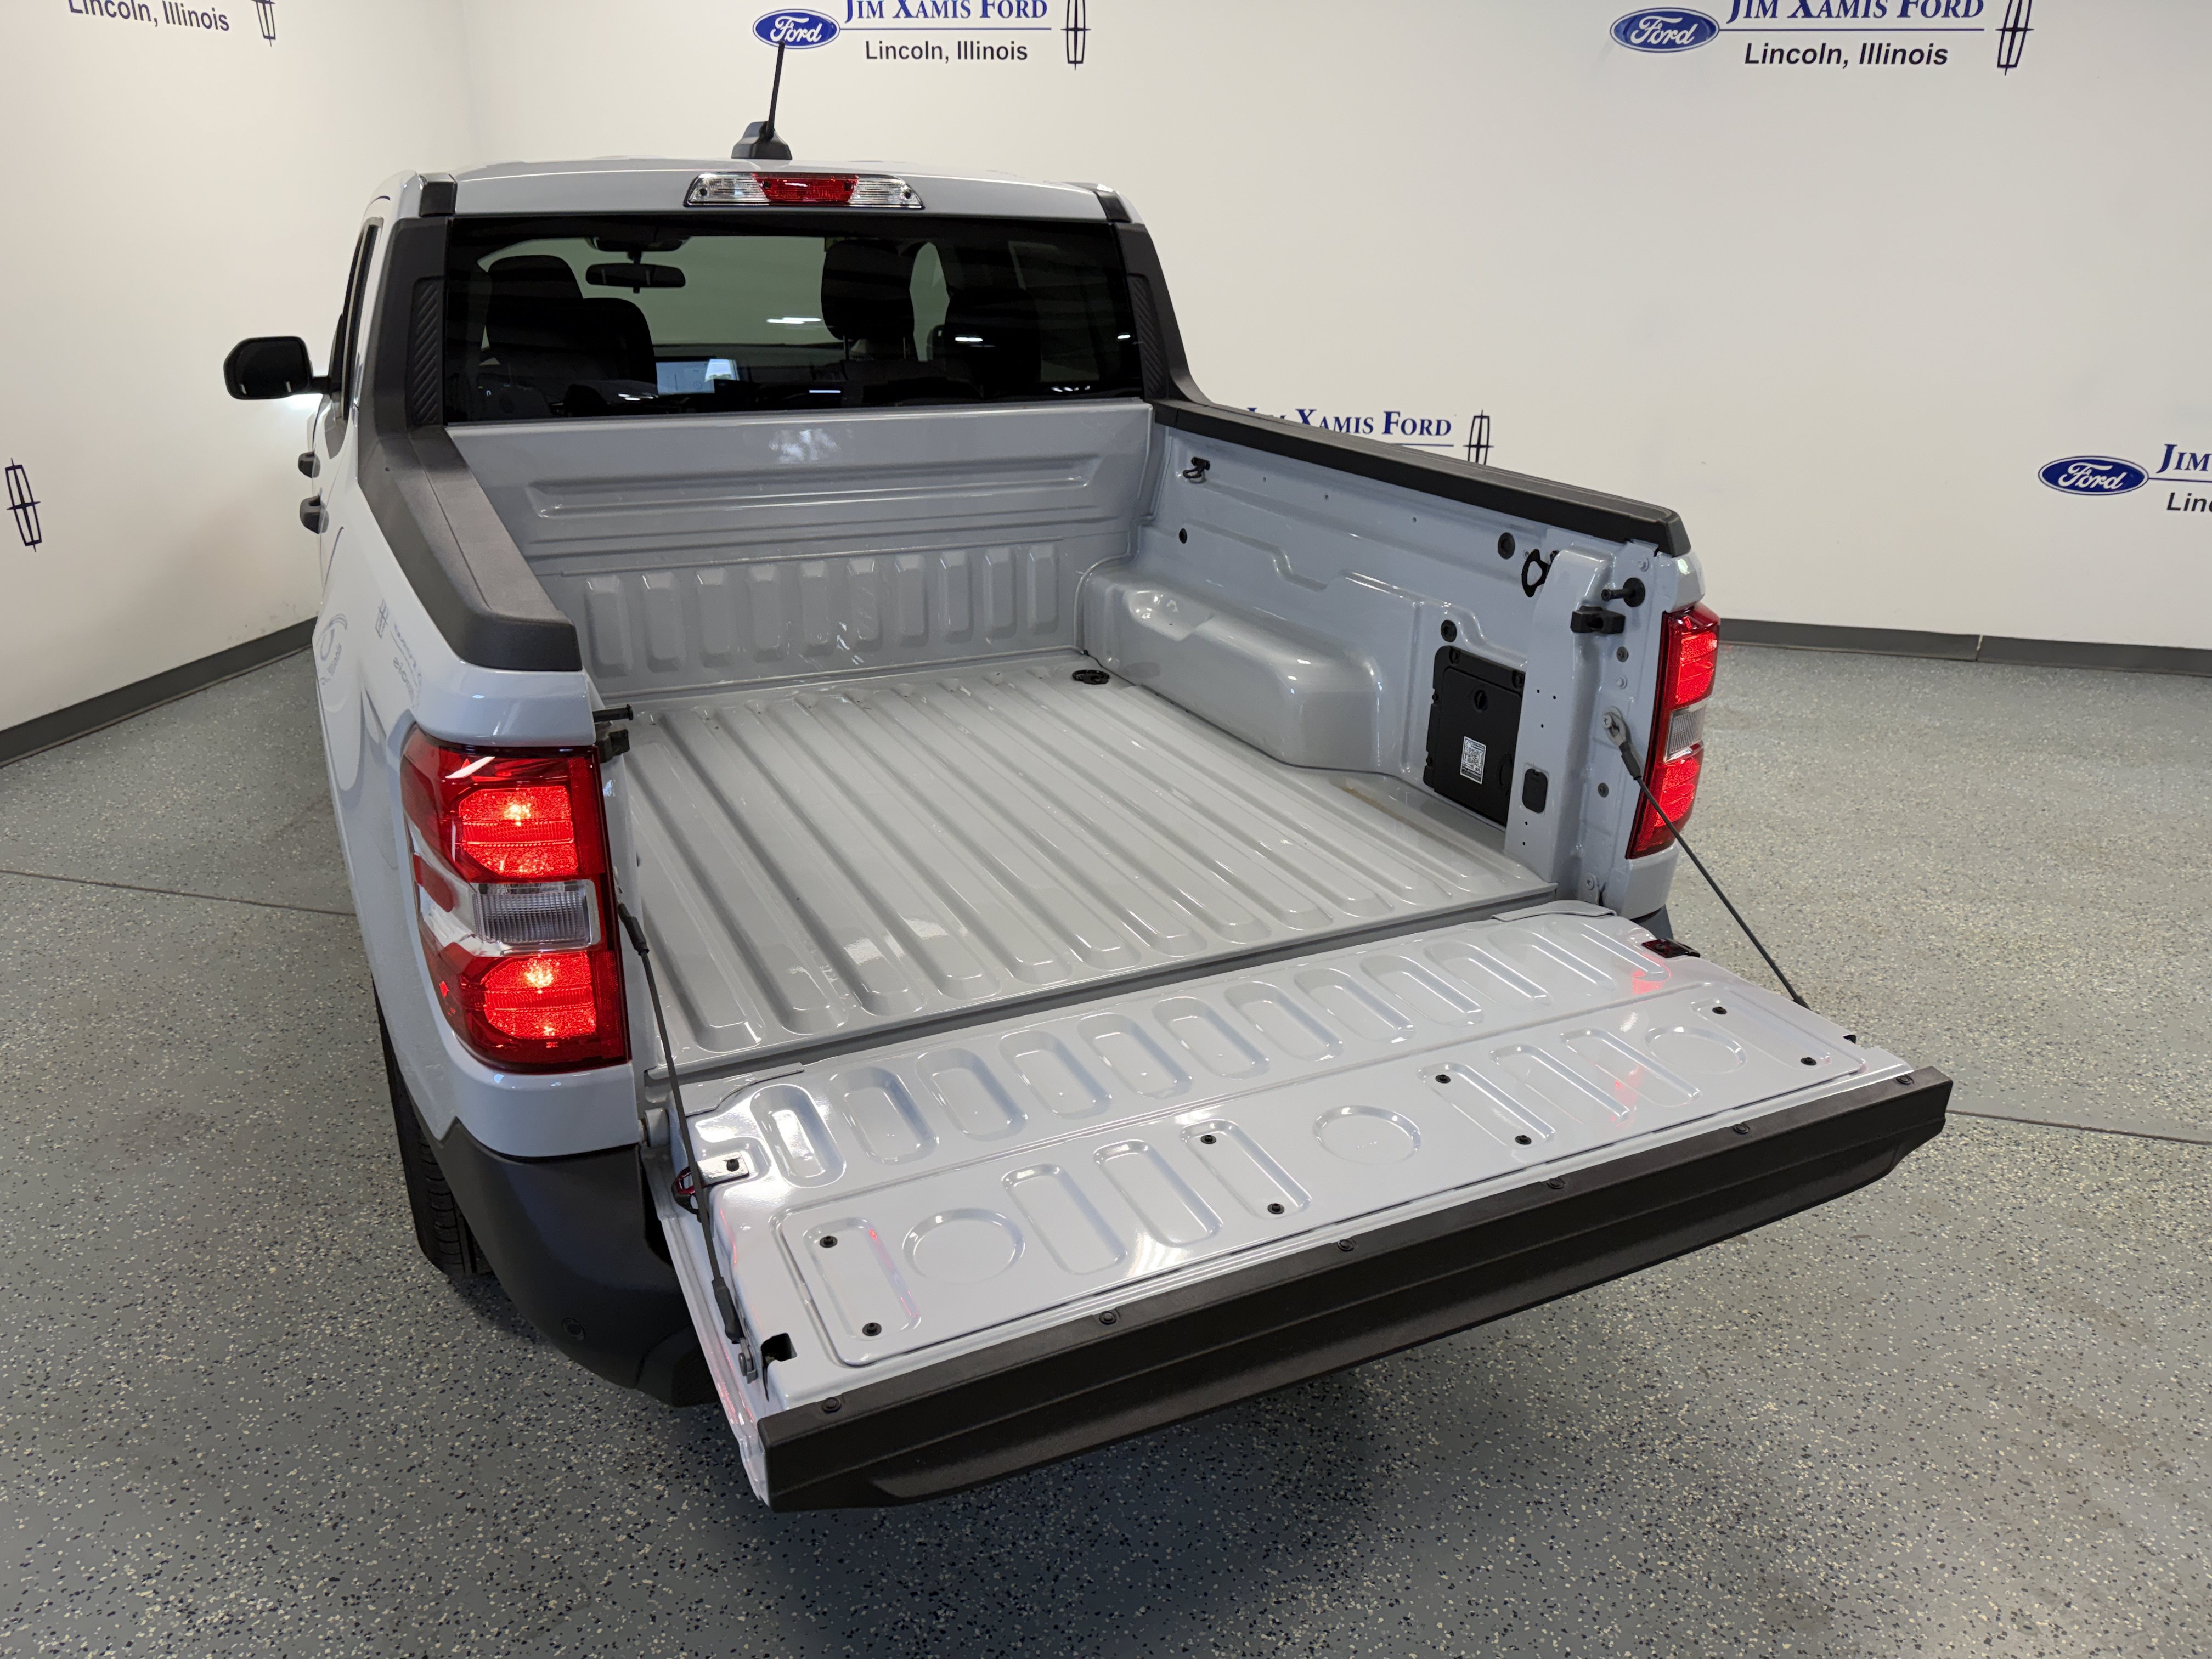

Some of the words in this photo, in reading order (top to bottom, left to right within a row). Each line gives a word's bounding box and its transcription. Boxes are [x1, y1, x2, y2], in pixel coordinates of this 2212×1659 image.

[162, 0, 229, 31] Illinois
[845, 0, 884, 24] JIM
[892, 0, 971, 19] XAMIS
[980, 0, 1047, 18] FORD
[1726, 0, 1778, 24] JIM
[1787, 0, 1888, 18] XAMIS
[1897, 0, 1984, 18] FORD
[770, 16, 822, 42] Ford
[1630, 16, 1699, 44] Ford
[866, 41, 949, 64] Lincoln,
[958, 41, 1028, 60] Illinois
[1745, 43, 1848, 69] Lincoln,
[1859, 43, 1948, 65] Illinois
[1382, 411, 1451, 436] FORD
[2156, 444, 2212, 473] JIM
[2058, 462, 2128, 489] Ford
